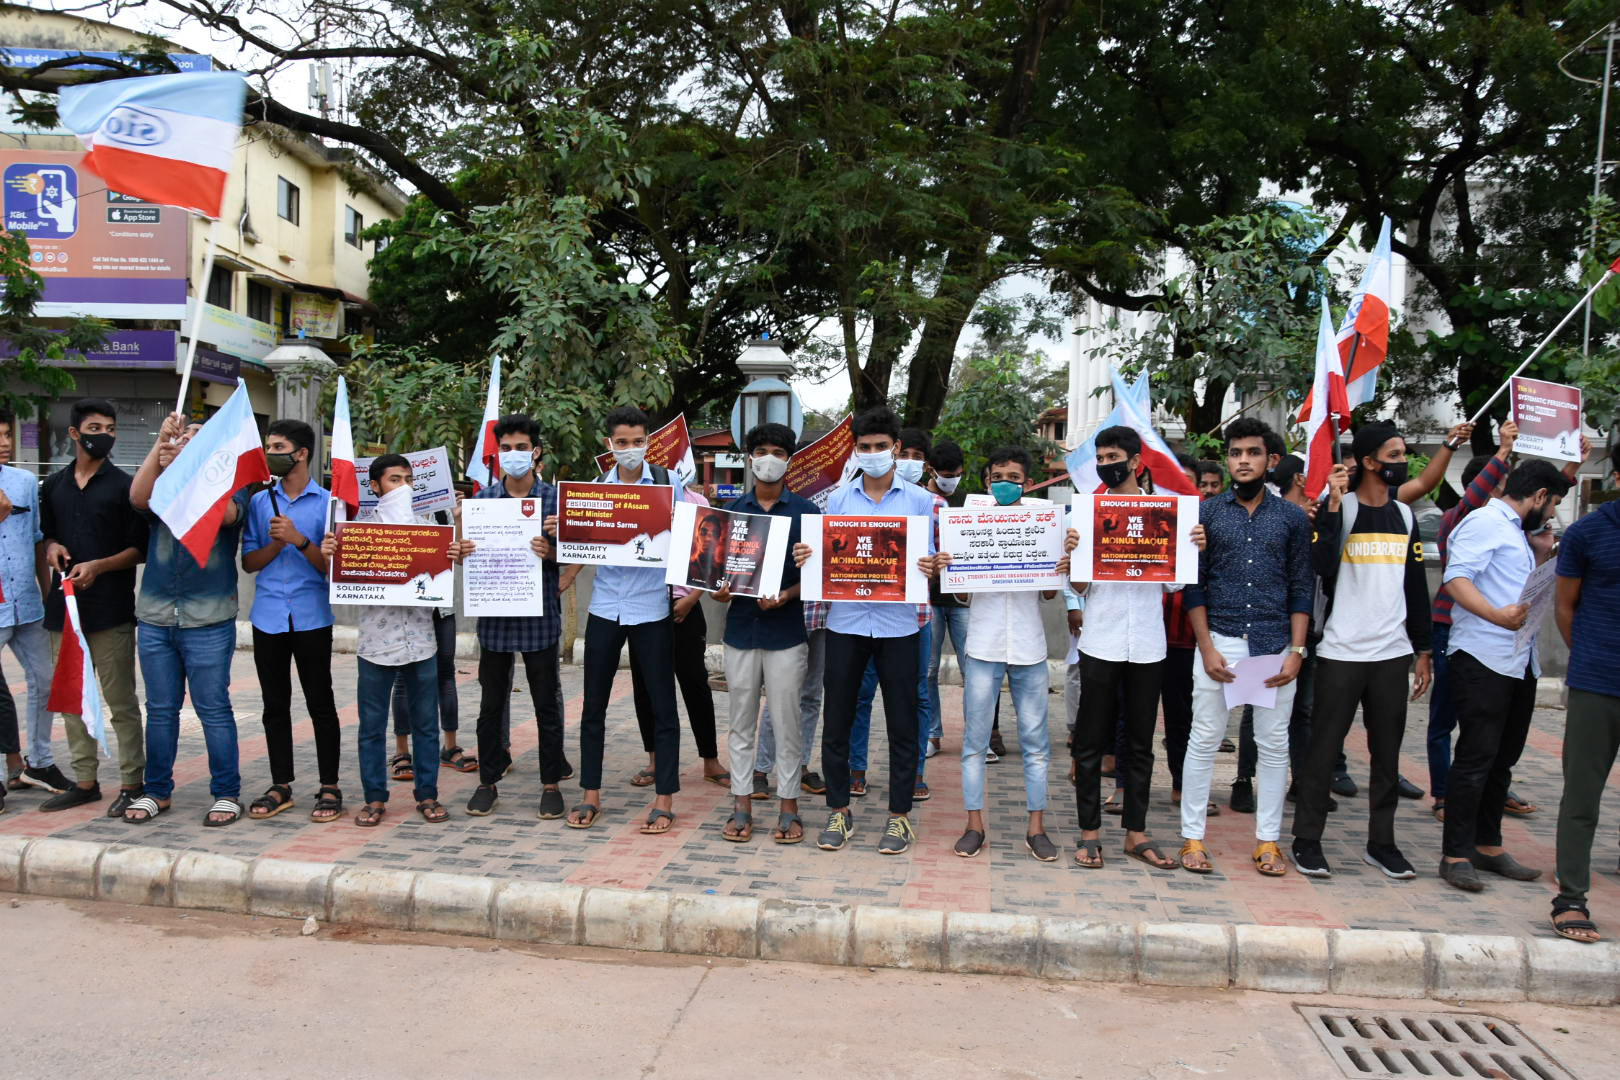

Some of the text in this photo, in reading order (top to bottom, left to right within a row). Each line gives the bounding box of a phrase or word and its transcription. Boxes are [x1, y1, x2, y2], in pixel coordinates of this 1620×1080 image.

[124, 214, 137, 222] App
[112, 341, 140, 351] Bank
[566, 490, 640, 500] Demanding immediate
[585, 510, 613, 518] Minister
[596, 520, 615, 528] Biswa
[734, 520, 747, 528] WE
[948, 515, 972, 524] ನಾನು
[1126, 523, 1144, 531] ARE
[730, 540, 760, 549] MOINUL
[1138, 538, 1168, 546] HAQUE
[1413, 542, 1424, 561] 9
[868, 558, 898, 566] HAQUE
[1126, 565, 1142, 576] sio
[948, 573, 965, 584] sio
[856, 584, 872, 596] sio
